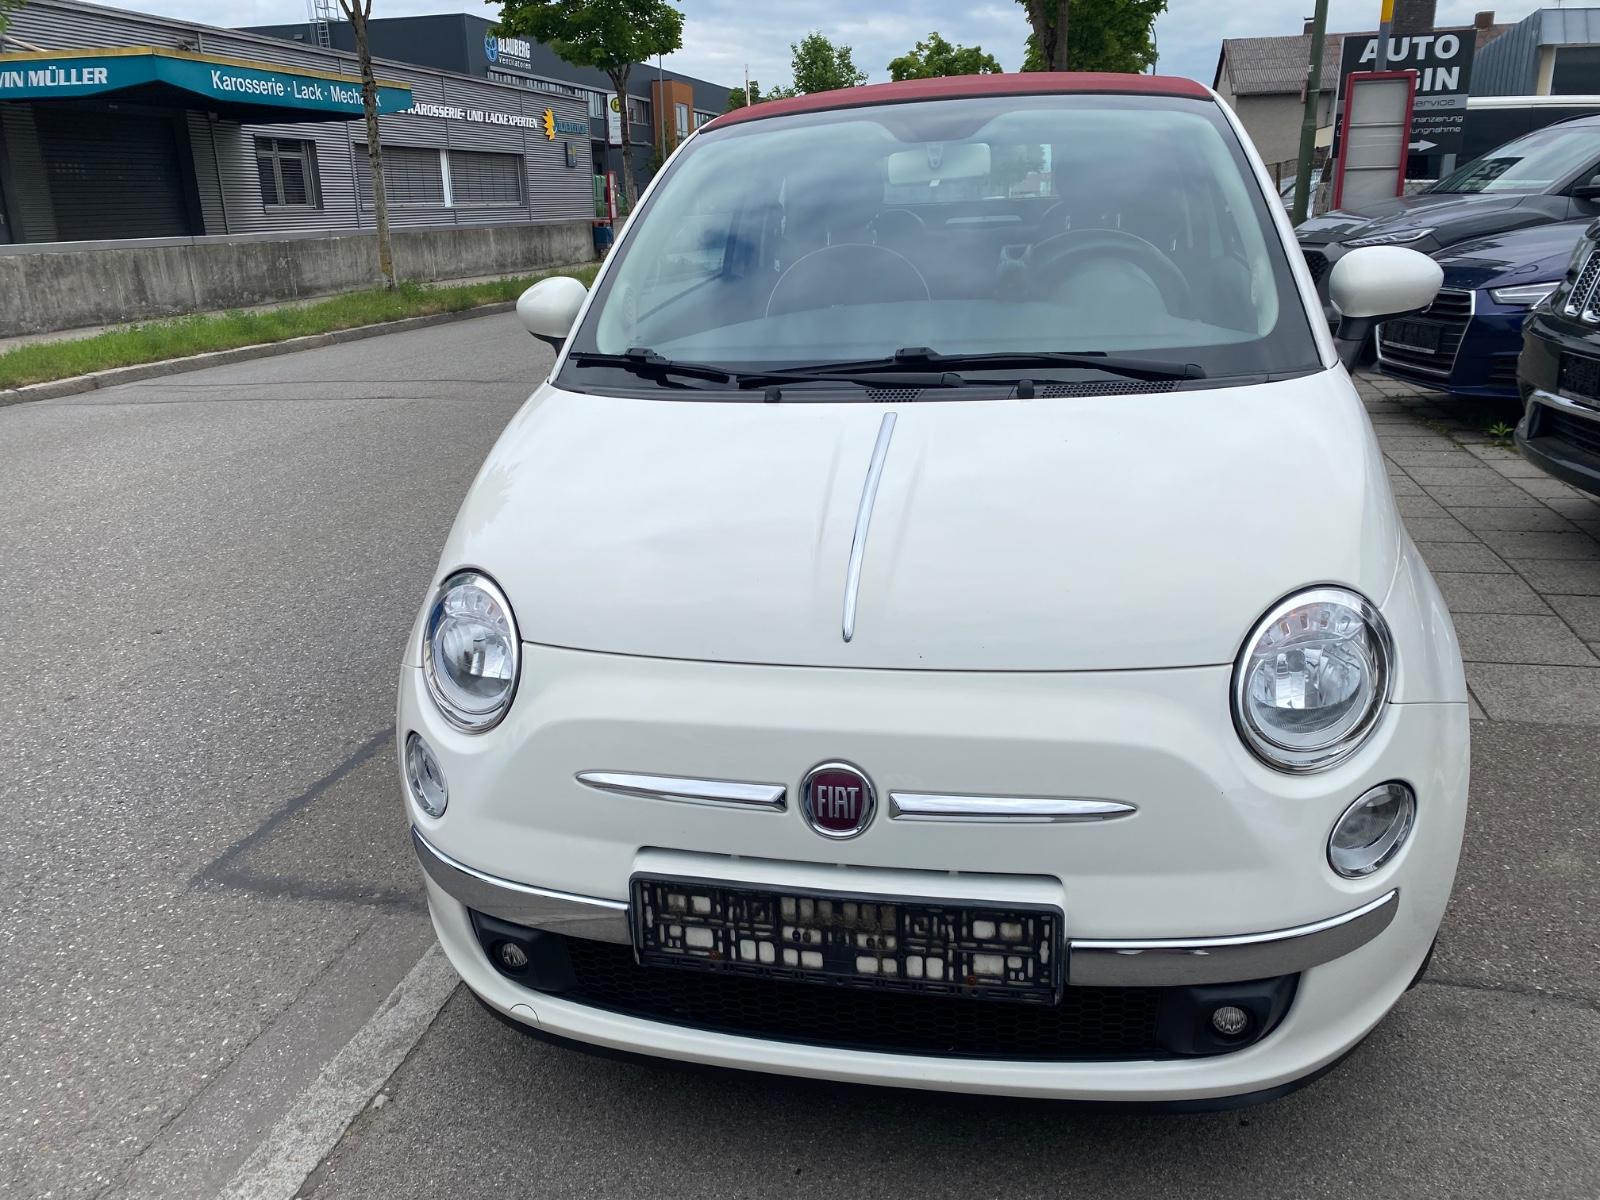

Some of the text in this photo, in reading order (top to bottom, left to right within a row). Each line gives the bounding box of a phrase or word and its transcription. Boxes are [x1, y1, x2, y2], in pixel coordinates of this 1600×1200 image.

[497, 37, 531, 59] BLAUBERG
[1359, 34, 1460, 63] AUTO
[28, 65, 108, 87] MÜLLER
[211, 70, 382, 107] Karosserie Lack Mechk
[1414, 99, 1456, 107] ervice
[467, 109, 483, 122] UND
[485, 112, 538, 128] LACKEXPERTEN
[817, 785, 860, 820] FIAT
